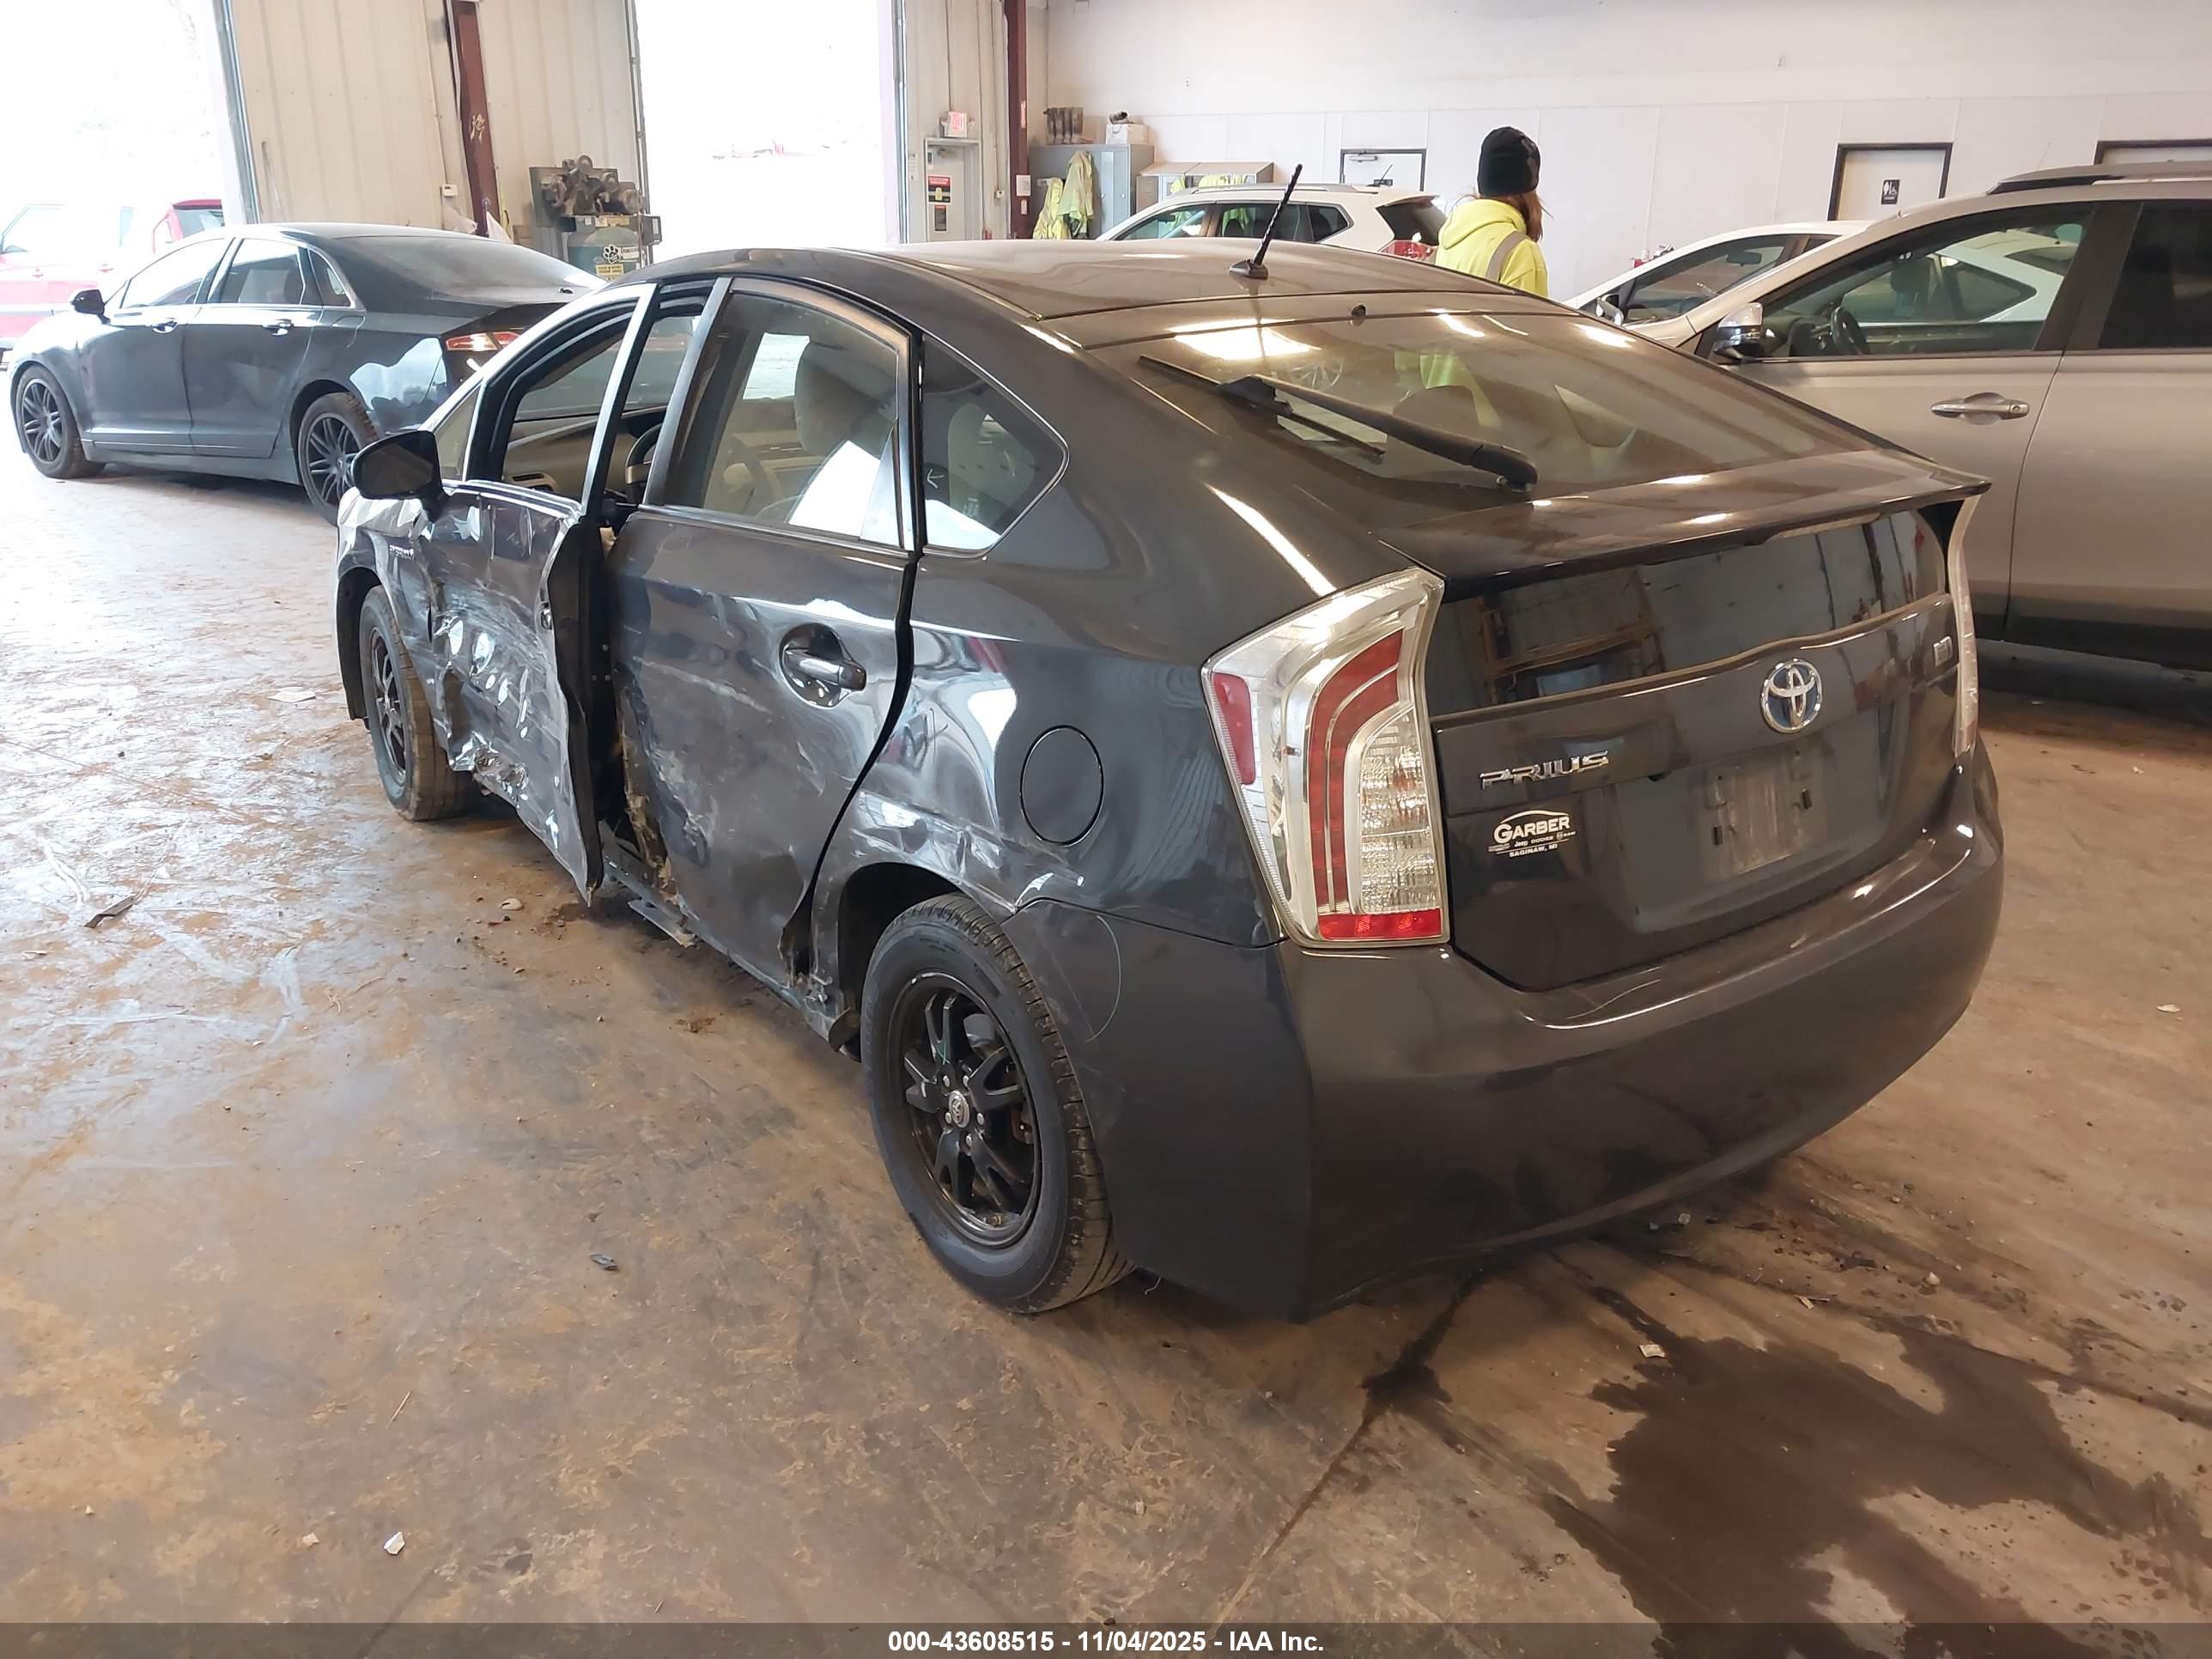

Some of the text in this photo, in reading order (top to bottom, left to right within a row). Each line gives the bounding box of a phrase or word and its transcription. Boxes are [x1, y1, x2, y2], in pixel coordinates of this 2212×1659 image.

[1480, 750, 1609, 790] PRIUS
[1494, 816, 1571, 844] GARBER
[1509, 846, 1548, 858] SAGINAW,
